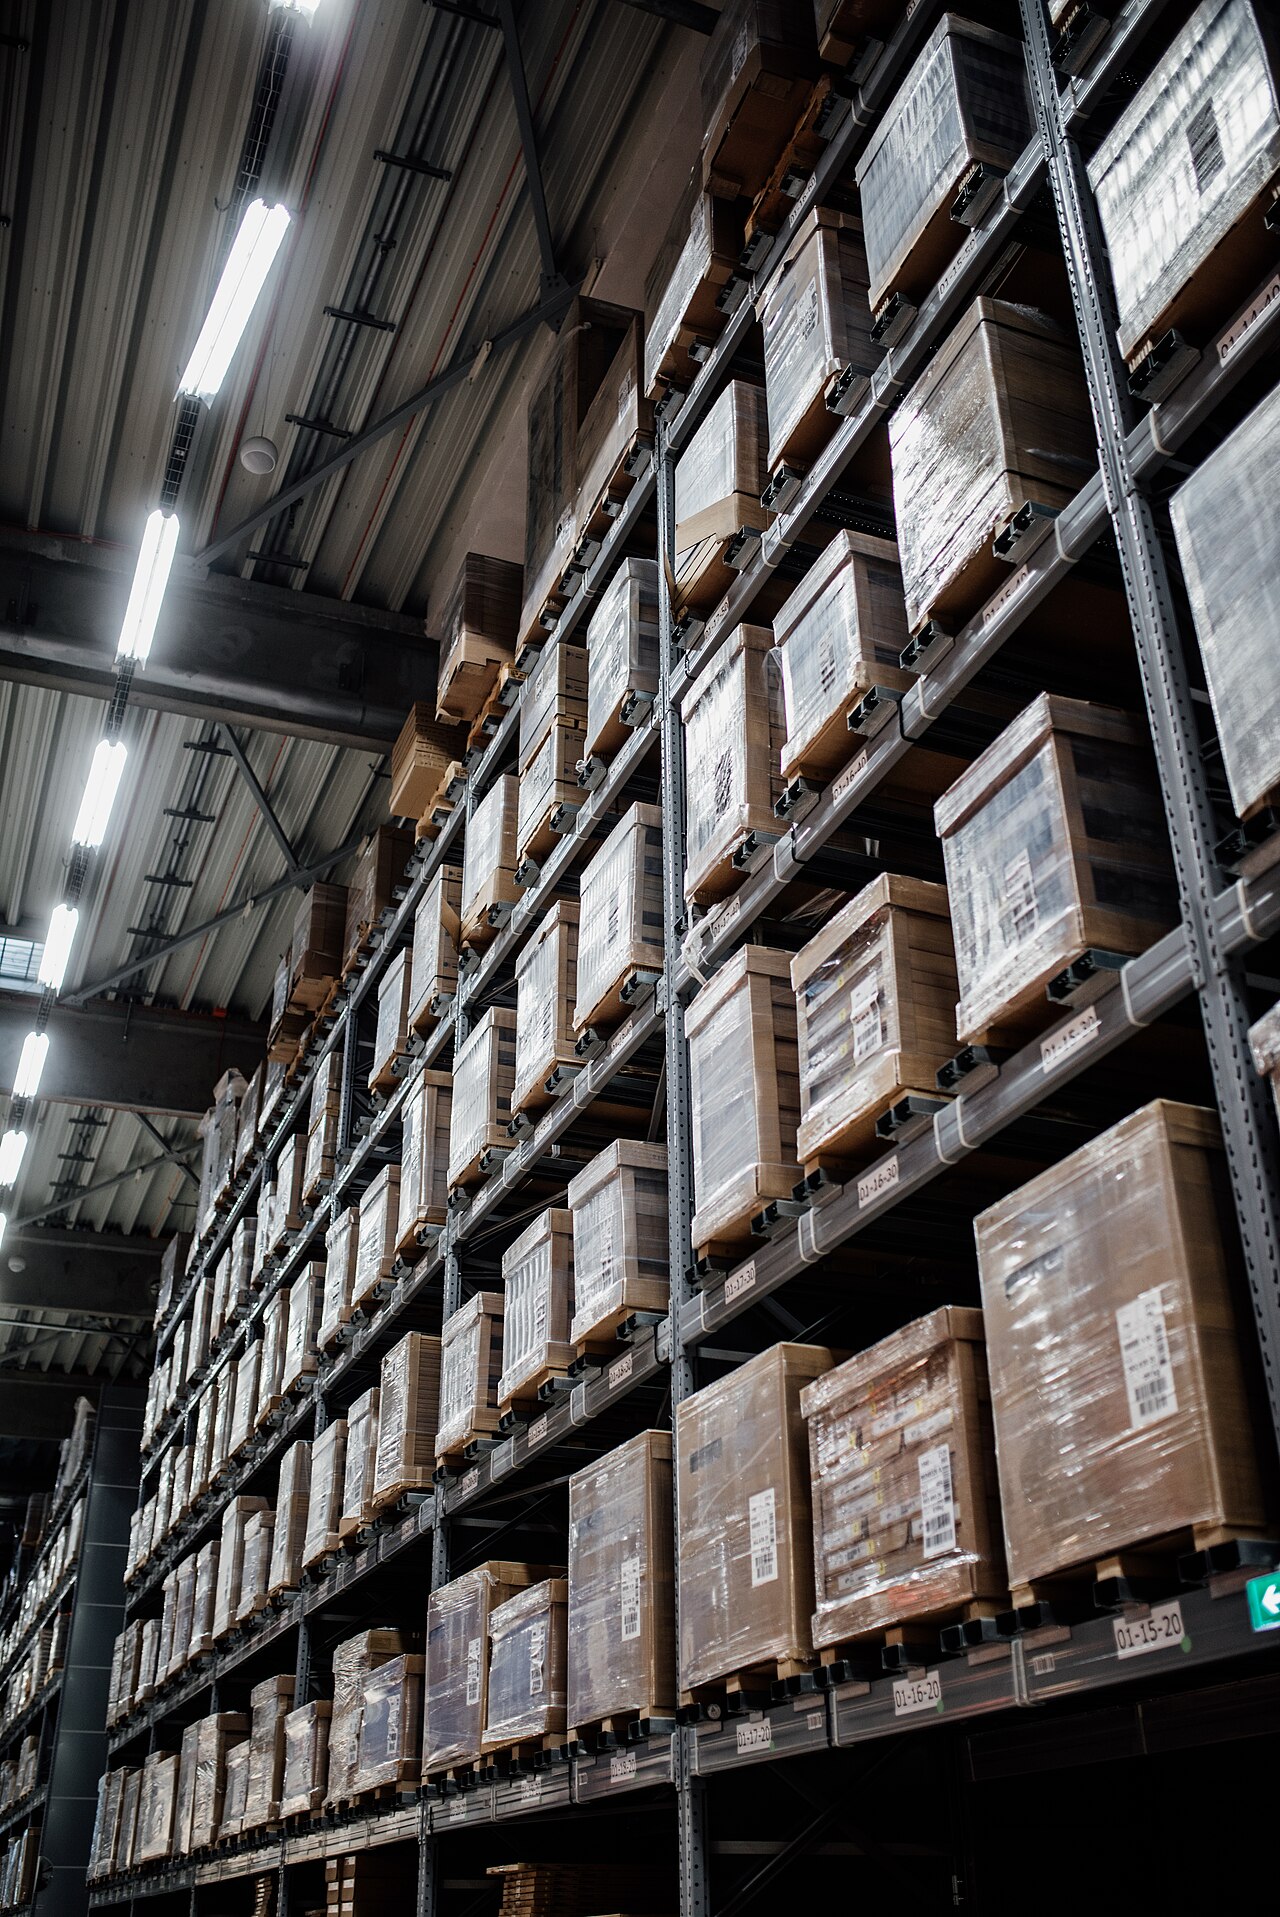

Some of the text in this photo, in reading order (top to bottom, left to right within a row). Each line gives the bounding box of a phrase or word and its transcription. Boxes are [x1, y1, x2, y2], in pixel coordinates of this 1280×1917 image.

[859, 1163, 897, 1202] 01-16-30
[725, 1267, 755, 1299] 01-17-30
[1117, 1613, 1182, 1650] 01-15-20
[895, 1680, 941, 1708] 01-16-20
[736, 1725, 771, 1748] 01-17-20
